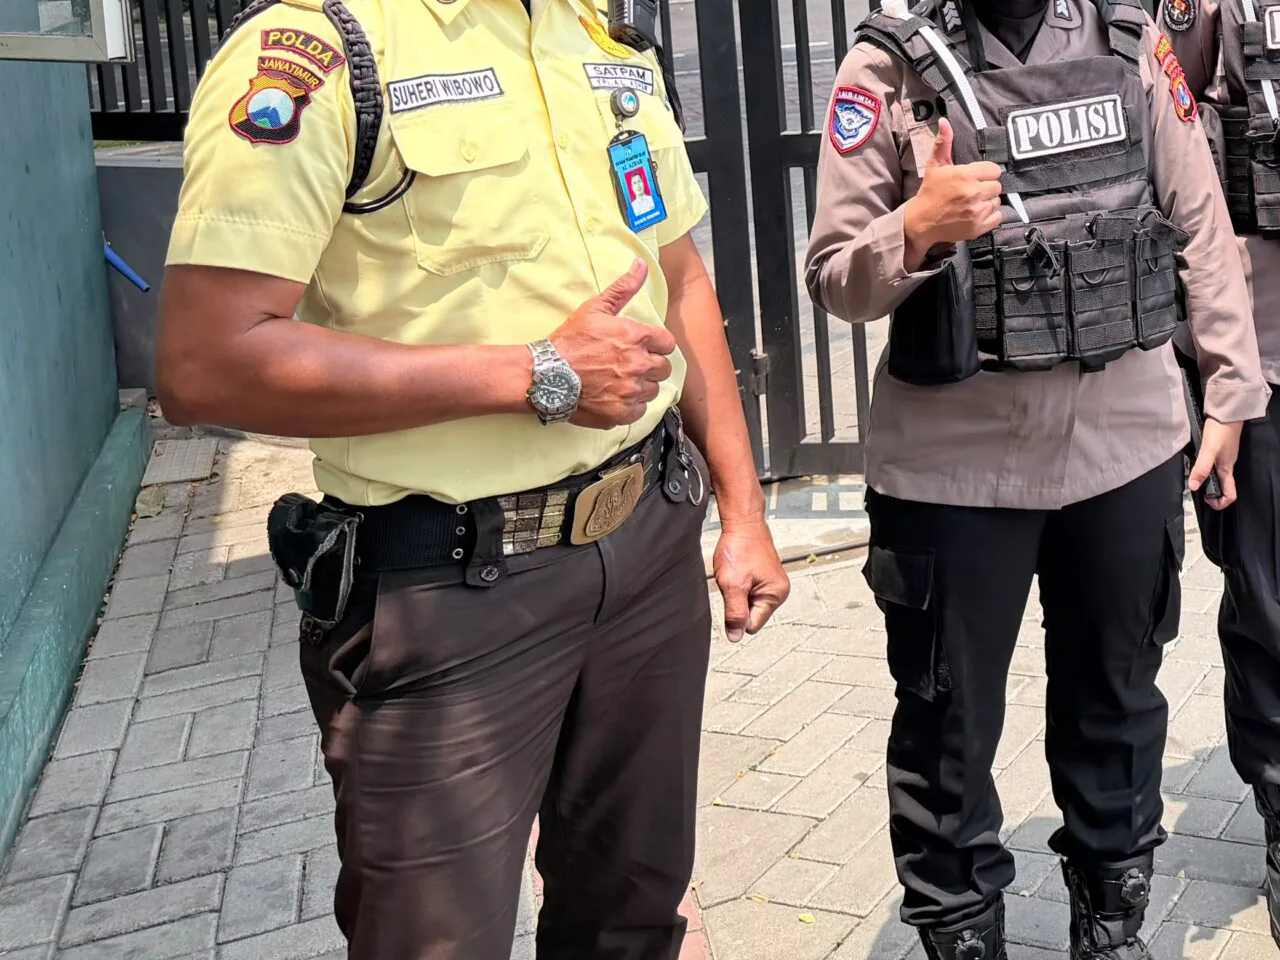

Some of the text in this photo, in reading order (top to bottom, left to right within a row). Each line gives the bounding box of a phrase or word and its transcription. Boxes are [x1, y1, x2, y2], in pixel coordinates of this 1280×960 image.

[268, 31, 333, 66] POLDA
[392, 73, 495, 107] SUHERI WIBOWO
[592, 66, 646, 81] SATPAM
[1014, 101, 1118, 152] POLISI
